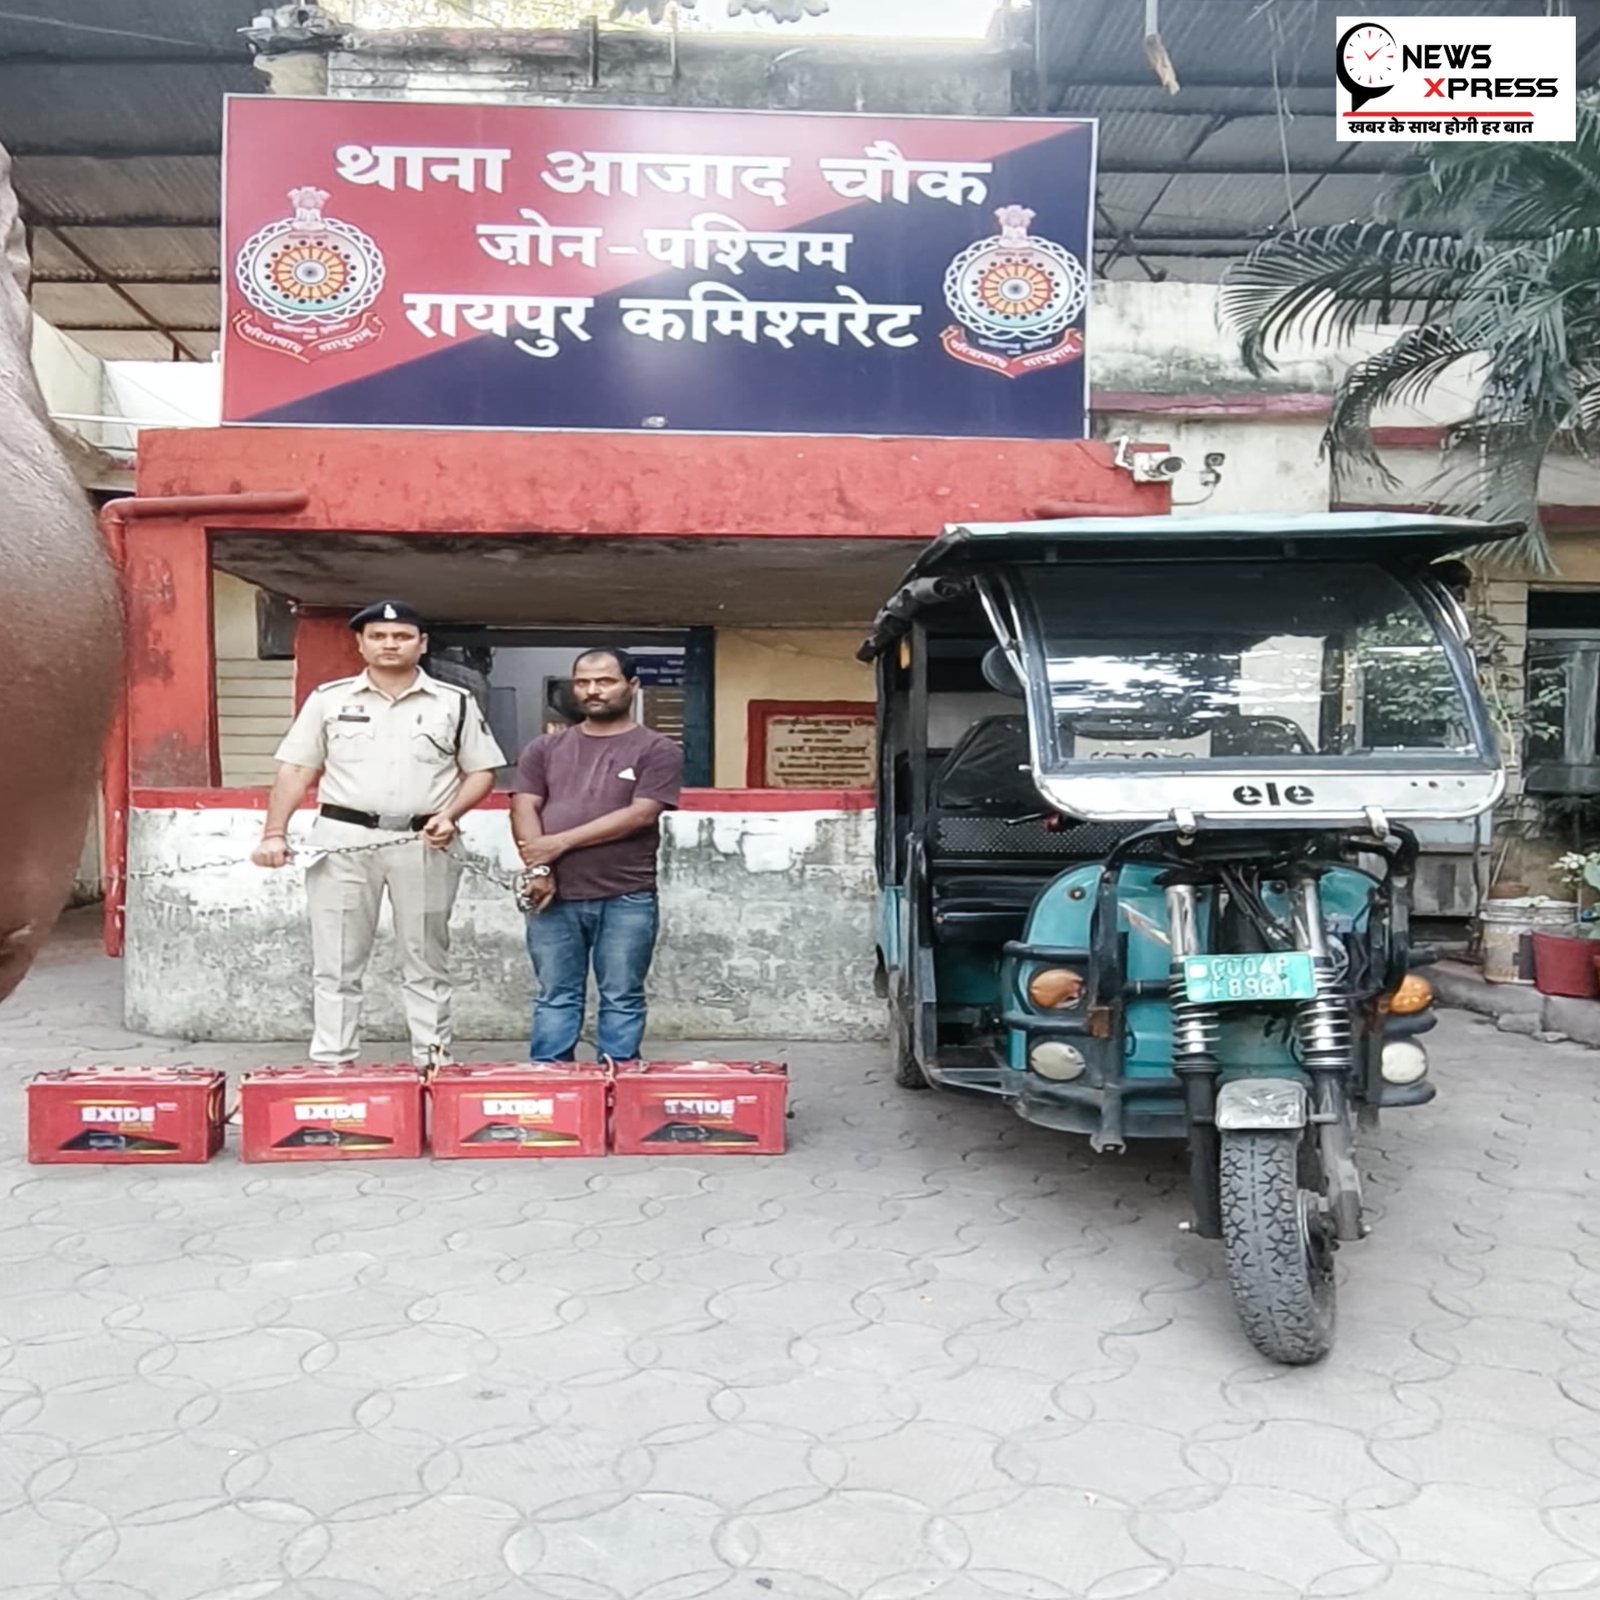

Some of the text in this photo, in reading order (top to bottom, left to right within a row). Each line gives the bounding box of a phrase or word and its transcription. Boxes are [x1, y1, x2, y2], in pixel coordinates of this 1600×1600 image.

[335, 140, 993, 206] थाना आजाद चौक
[403, 281, 922, 358] रायपुर कमिश्नरेट
[1233, 782, 1315, 807] ele
[81, 1106, 156, 1122] EXIDE
[294, 1103, 368, 1120] EXIDE
[482, 1098, 554, 1115] EXIDE
[664, 1099, 736, 1115] EXIDE
